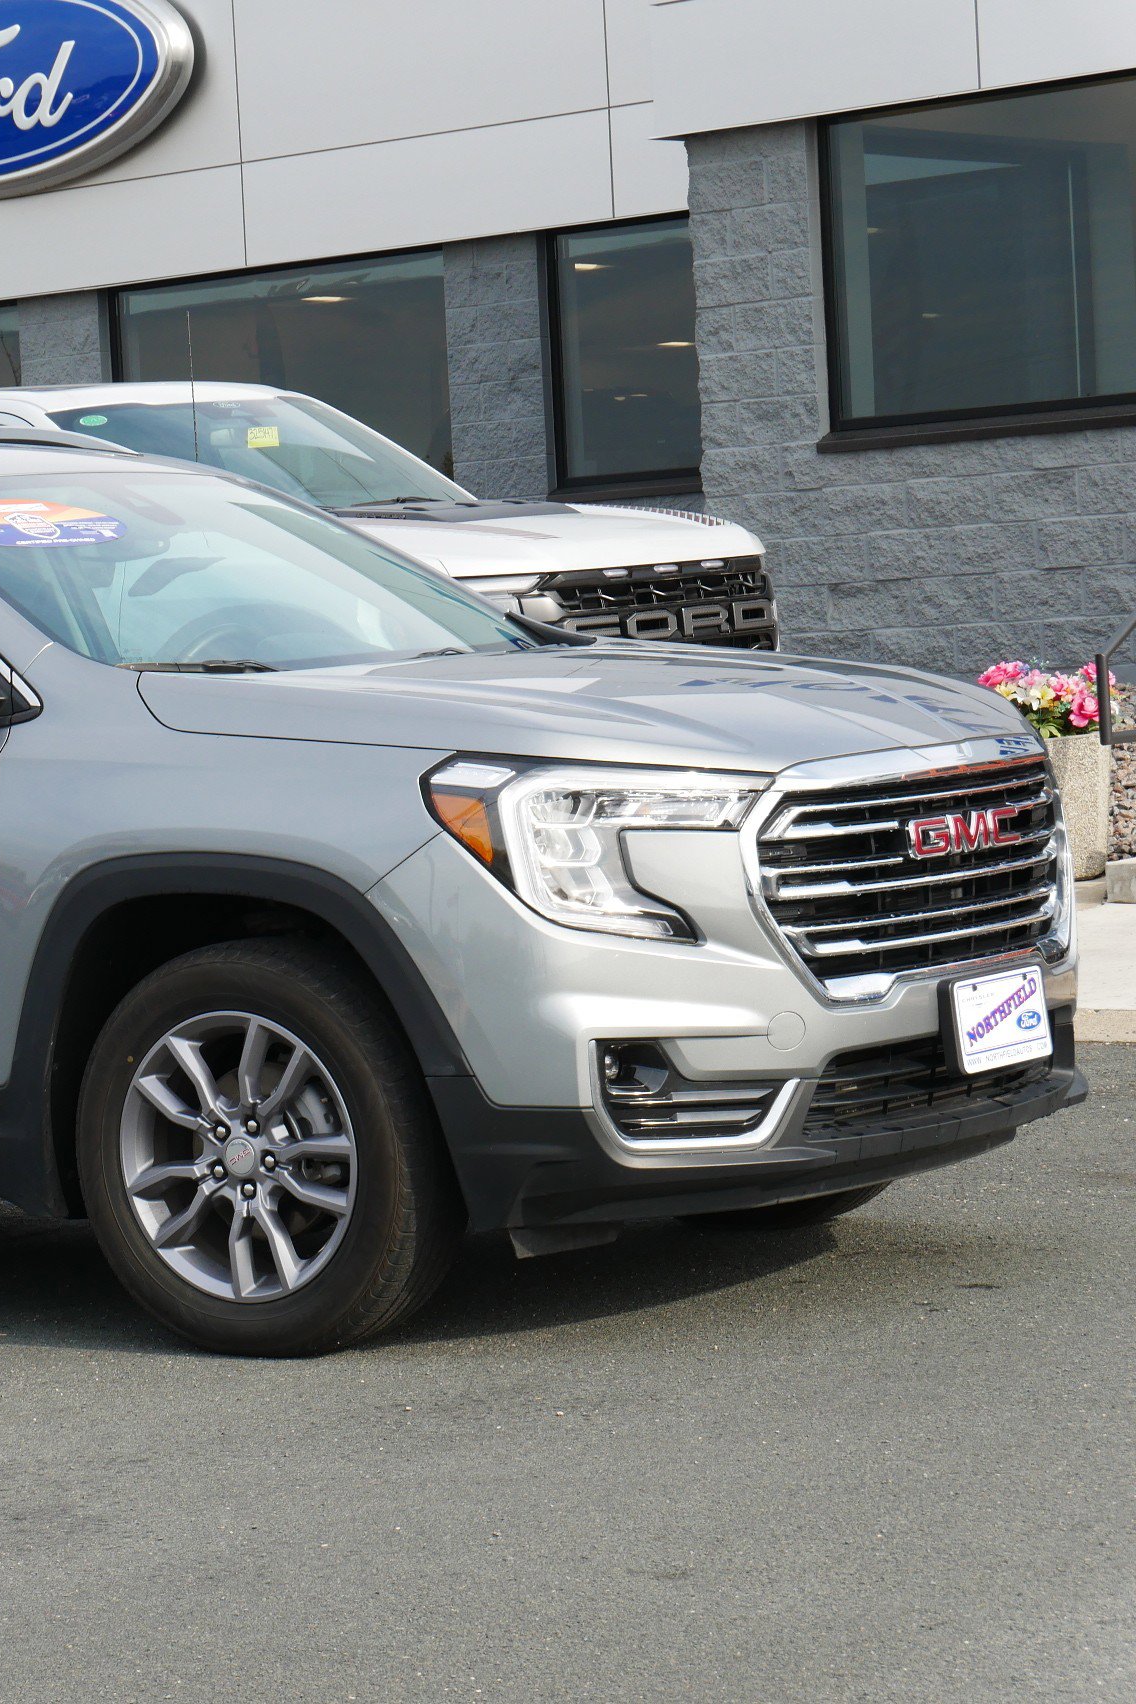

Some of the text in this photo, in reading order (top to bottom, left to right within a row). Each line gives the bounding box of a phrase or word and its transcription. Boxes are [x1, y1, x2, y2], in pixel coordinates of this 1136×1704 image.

[564, 600, 776, 639] FORD
[907, 806, 1022, 860] GMC
[966, 977, 1037, 1047] NORTHFIELD
[1020, 1012, 1039, 1029] Ford
